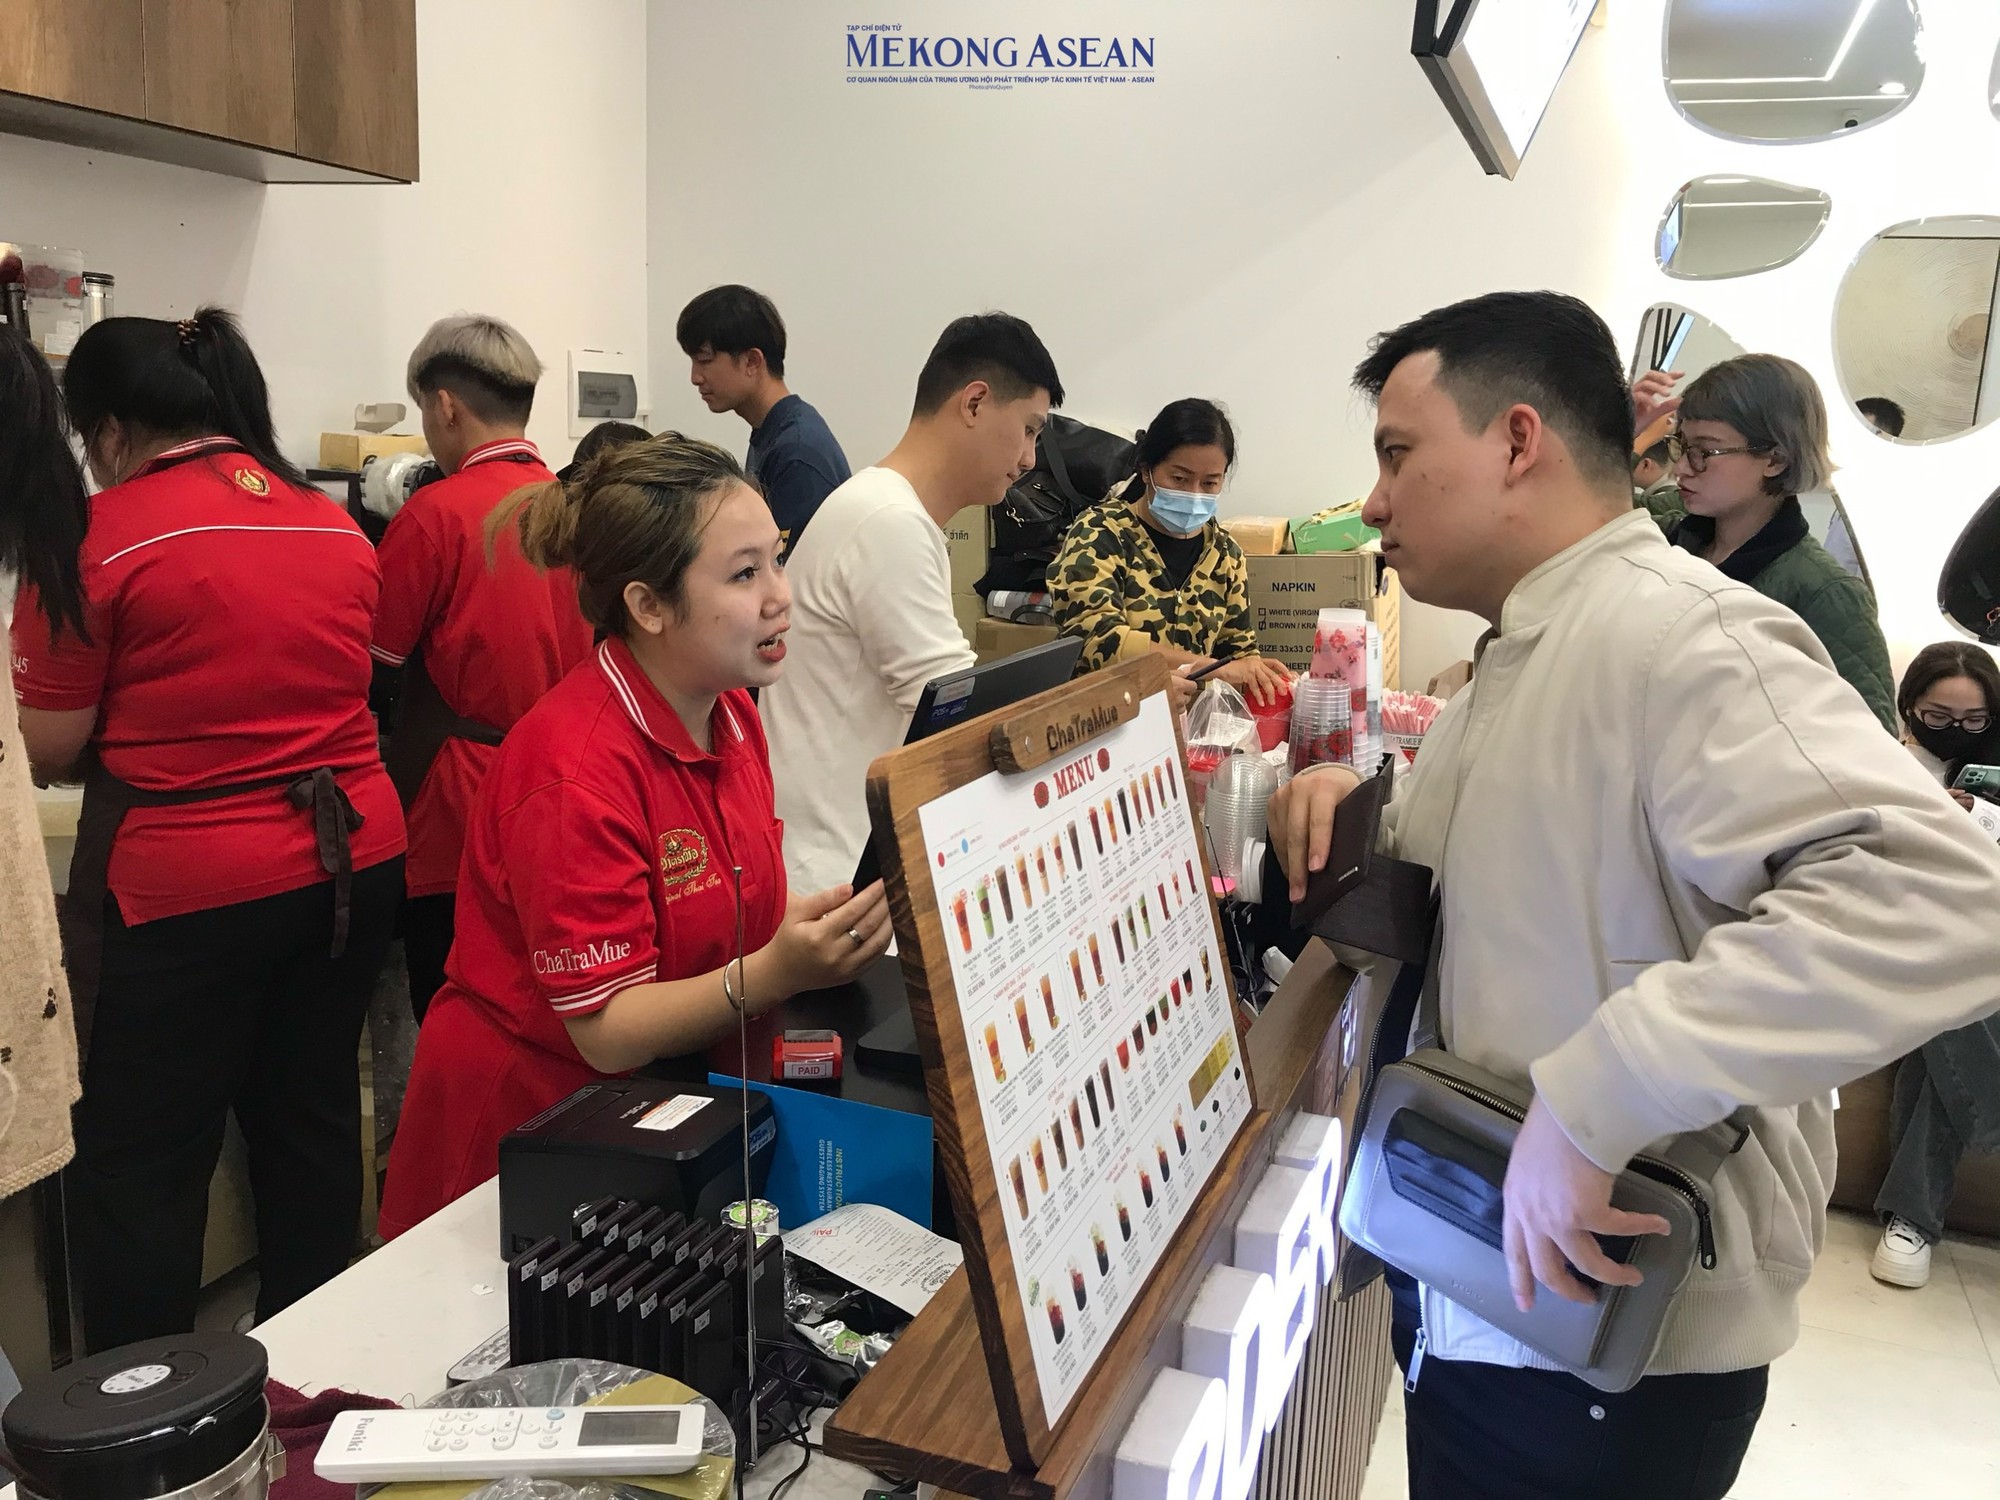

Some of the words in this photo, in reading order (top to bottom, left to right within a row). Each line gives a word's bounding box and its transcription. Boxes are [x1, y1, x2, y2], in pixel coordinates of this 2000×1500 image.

[1272, 582, 1316, 592] NAPKIN
[1258, 644, 1277, 652] SIZE
[1279, 645, 1303, 653] 33x33
[1046, 705, 1118, 751] ChaTraMue
[1053, 754, 1095, 800] MENU
[534, 940, 631, 974] ChaTraMue
[798, 1066, 820, 1075] PAID
[346, 1416, 374, 1452] Funiki
